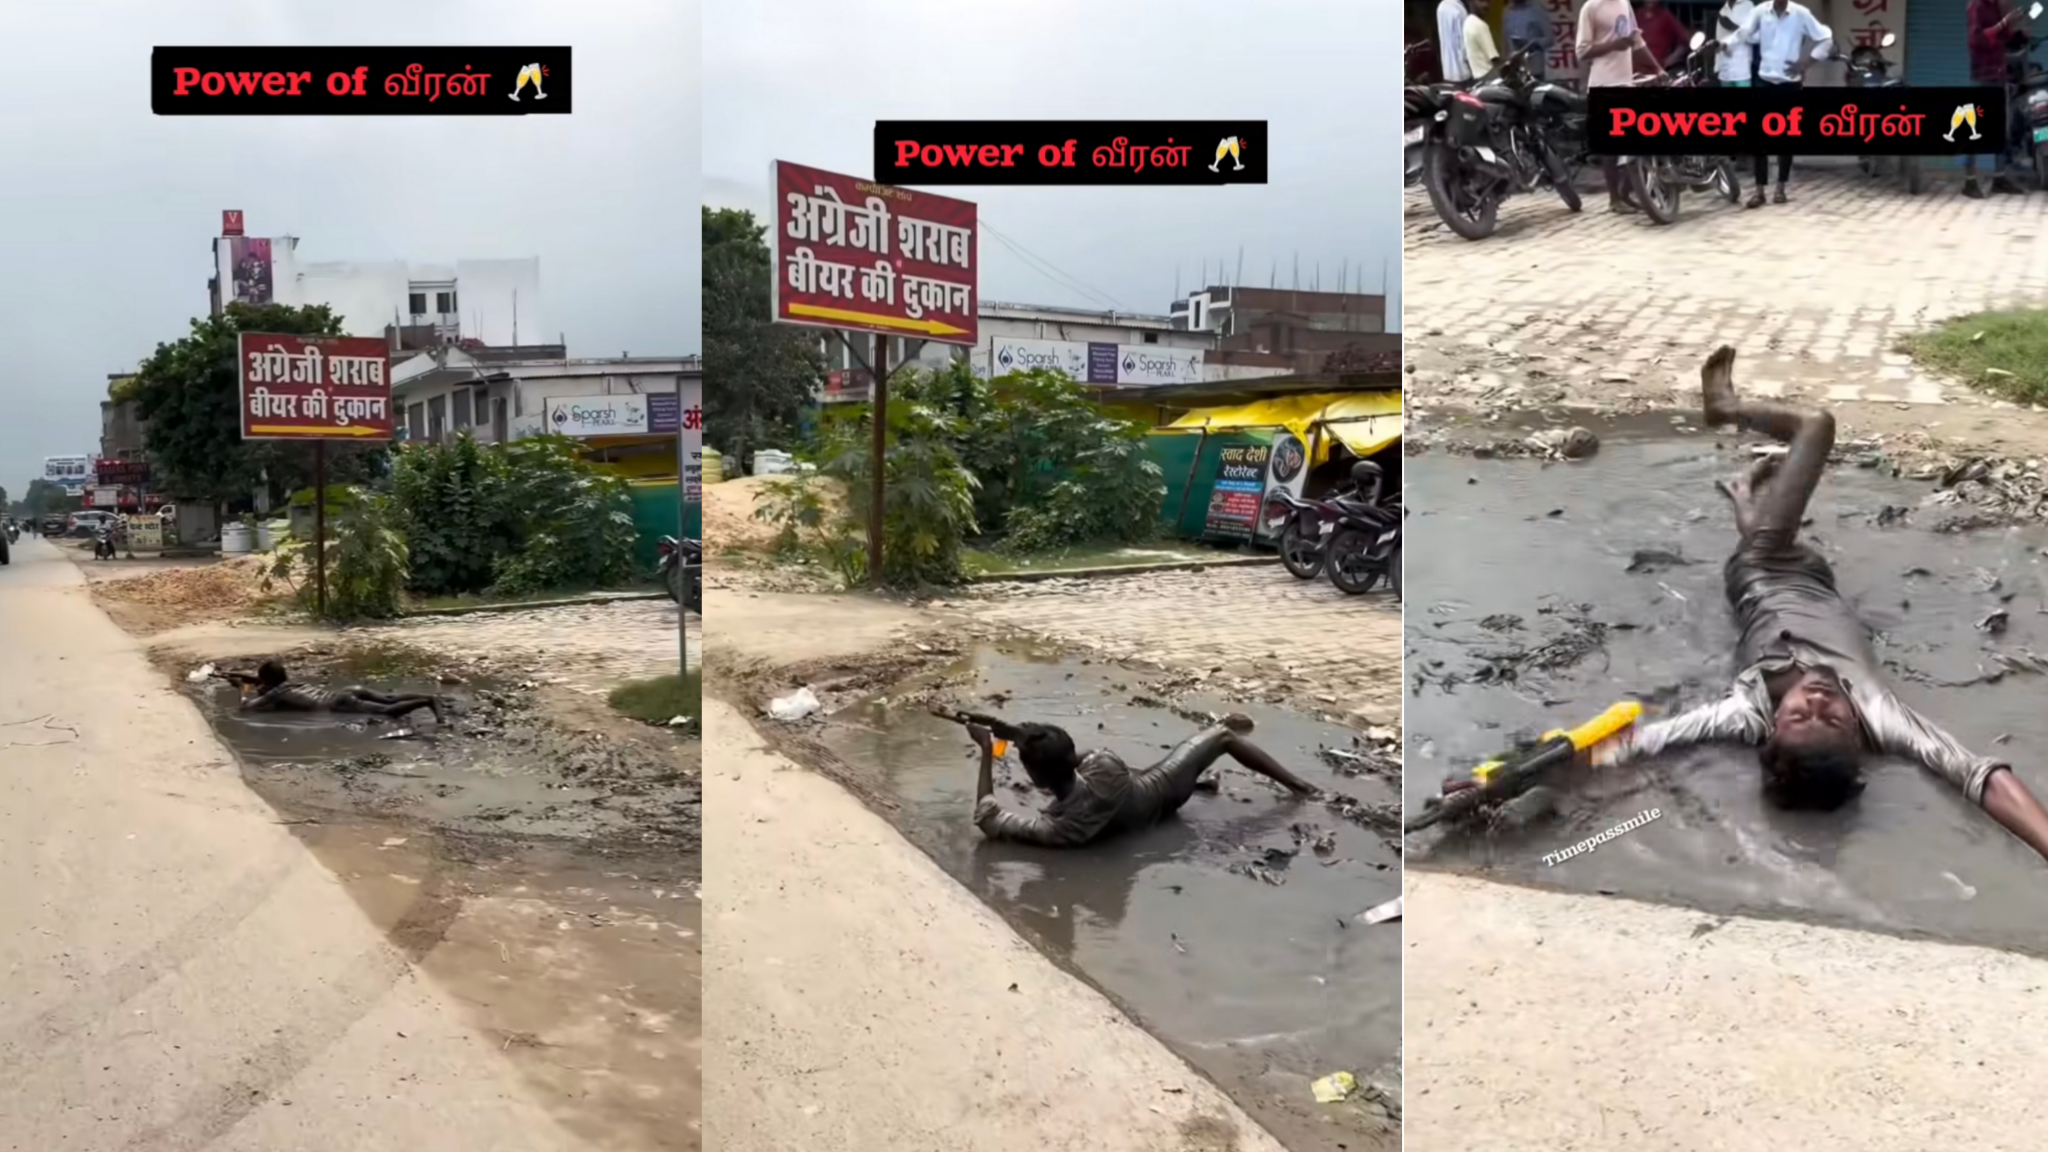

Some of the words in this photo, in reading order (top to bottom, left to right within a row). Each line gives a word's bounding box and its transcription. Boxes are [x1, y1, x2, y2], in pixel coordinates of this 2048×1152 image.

[787, 185, 891, 254] अंग्रेजी
[898, 215, 971, 268] शराब
[786, 246, 855, 299] बीयर
[860, 261, 896, 305] की
[902, 274, 971, 319] दुकान
[249, 344, 323, 384] अंग्रेजी
[328, 355, 385, 385] शराब
[1017, 347, 1060, 368] Sparsh
[1139, 354, 1176, 377] Sparsh
[249, 386, 298, 417] बीयर
[301, 388, 328, 418] की
[332, 396, 386, 425] दुकान
[572, 402, 616, 428] Sparsh
[1221, 448, 1244, 461] स्वाद
[1246, 446, 1268, 462] देशी
